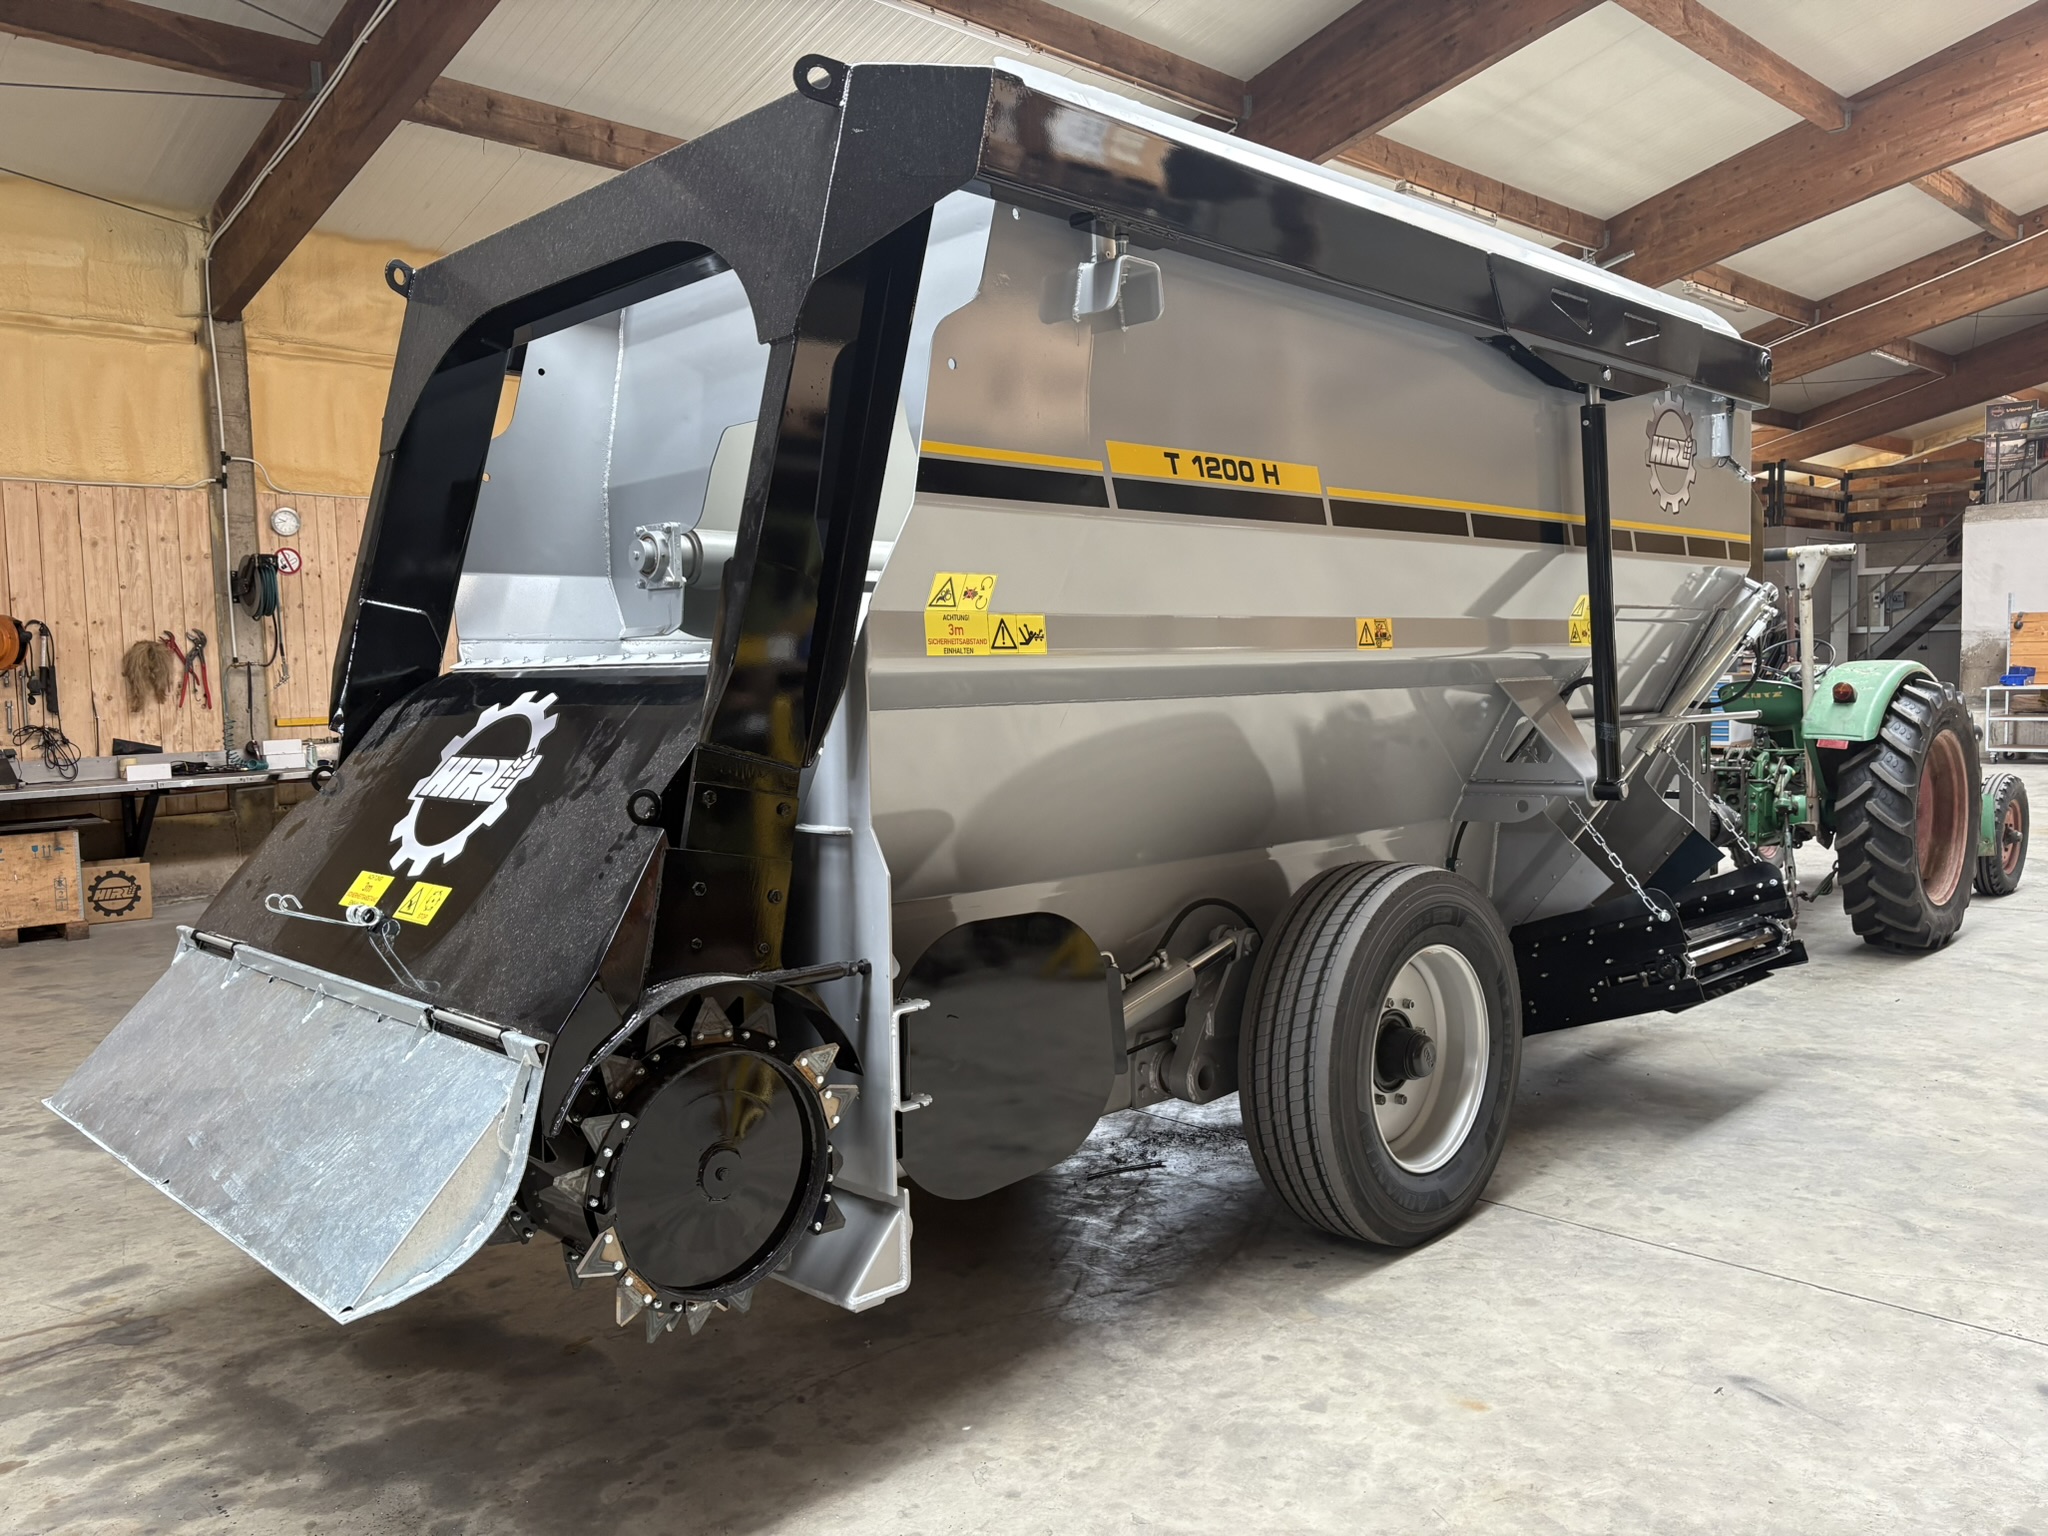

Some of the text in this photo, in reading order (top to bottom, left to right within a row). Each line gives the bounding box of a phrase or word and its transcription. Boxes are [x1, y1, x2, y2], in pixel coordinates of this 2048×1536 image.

[1163, 451, 1281, 486] T 1200 H
[948, 624, 964, 636] 3m
[93, 887, 135, 901] HIRL
